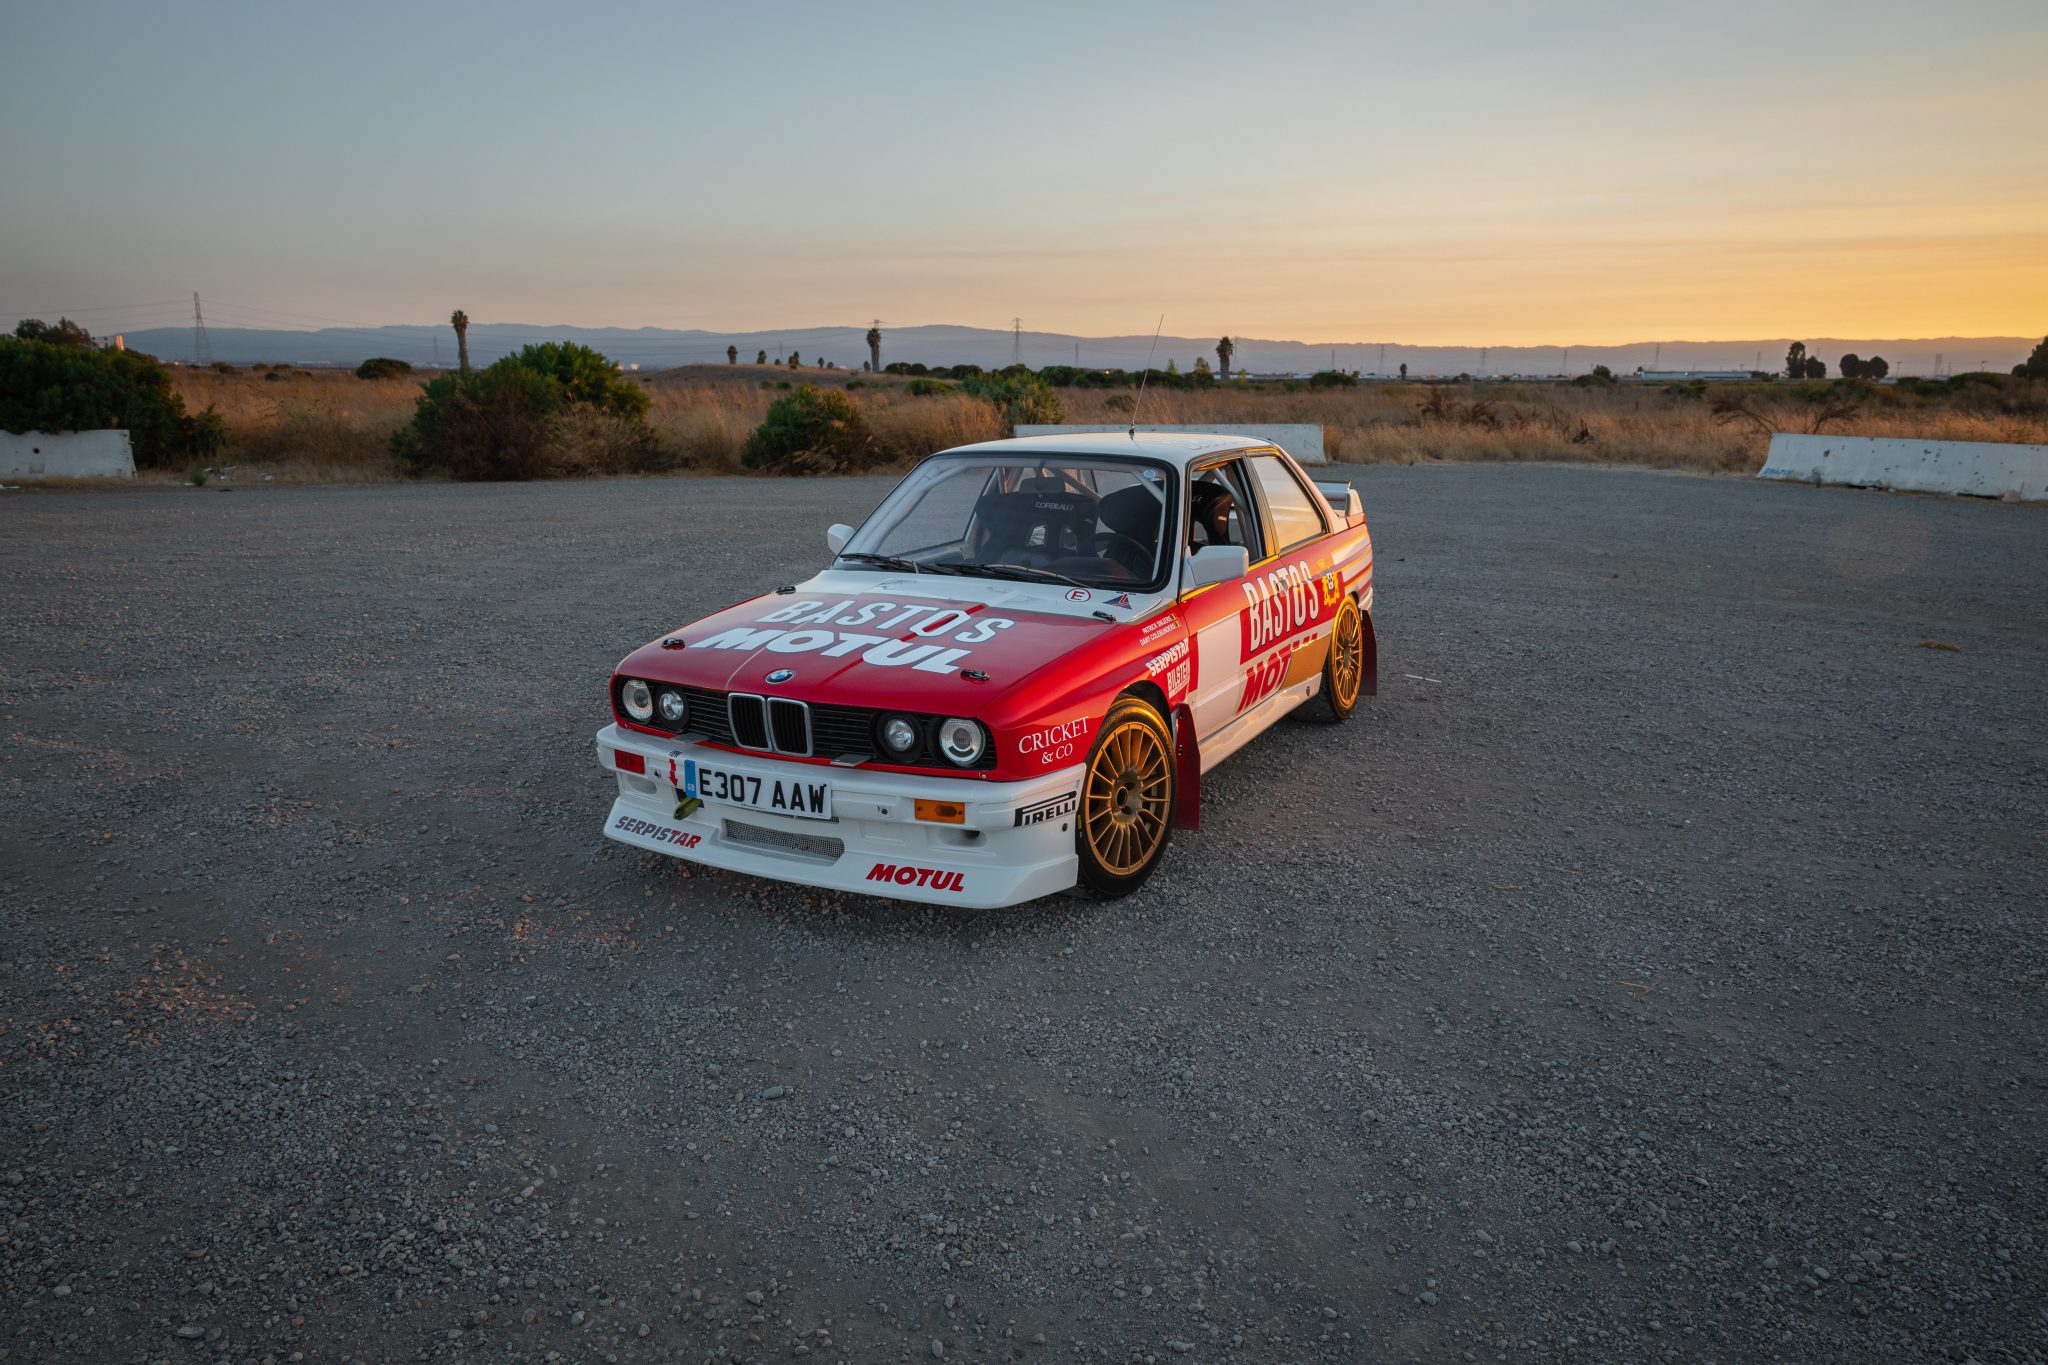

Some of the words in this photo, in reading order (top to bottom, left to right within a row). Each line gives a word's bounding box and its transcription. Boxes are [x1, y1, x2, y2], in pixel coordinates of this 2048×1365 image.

[755, 600, 1015, 643] BASTOS
[1241, 559, 1319, 652] BASTOS
[687, 627, 972, 675] MOTUL
[1145, 637, 1189, 677] SERPISTAR
[1018, 716, 1089, 754] CRICKET
[1041, 751, 1054, 765] &
[1055, 743, 1073, 760] CO
[699, 767, 762, 805] E307
[771, 780, 826, 813] AAW
[1013, 790, 1077, 828] PIRELLI
[614, 815, 702, 849] SERPISTAR
[865, 863, 965, 892] MOTUL
